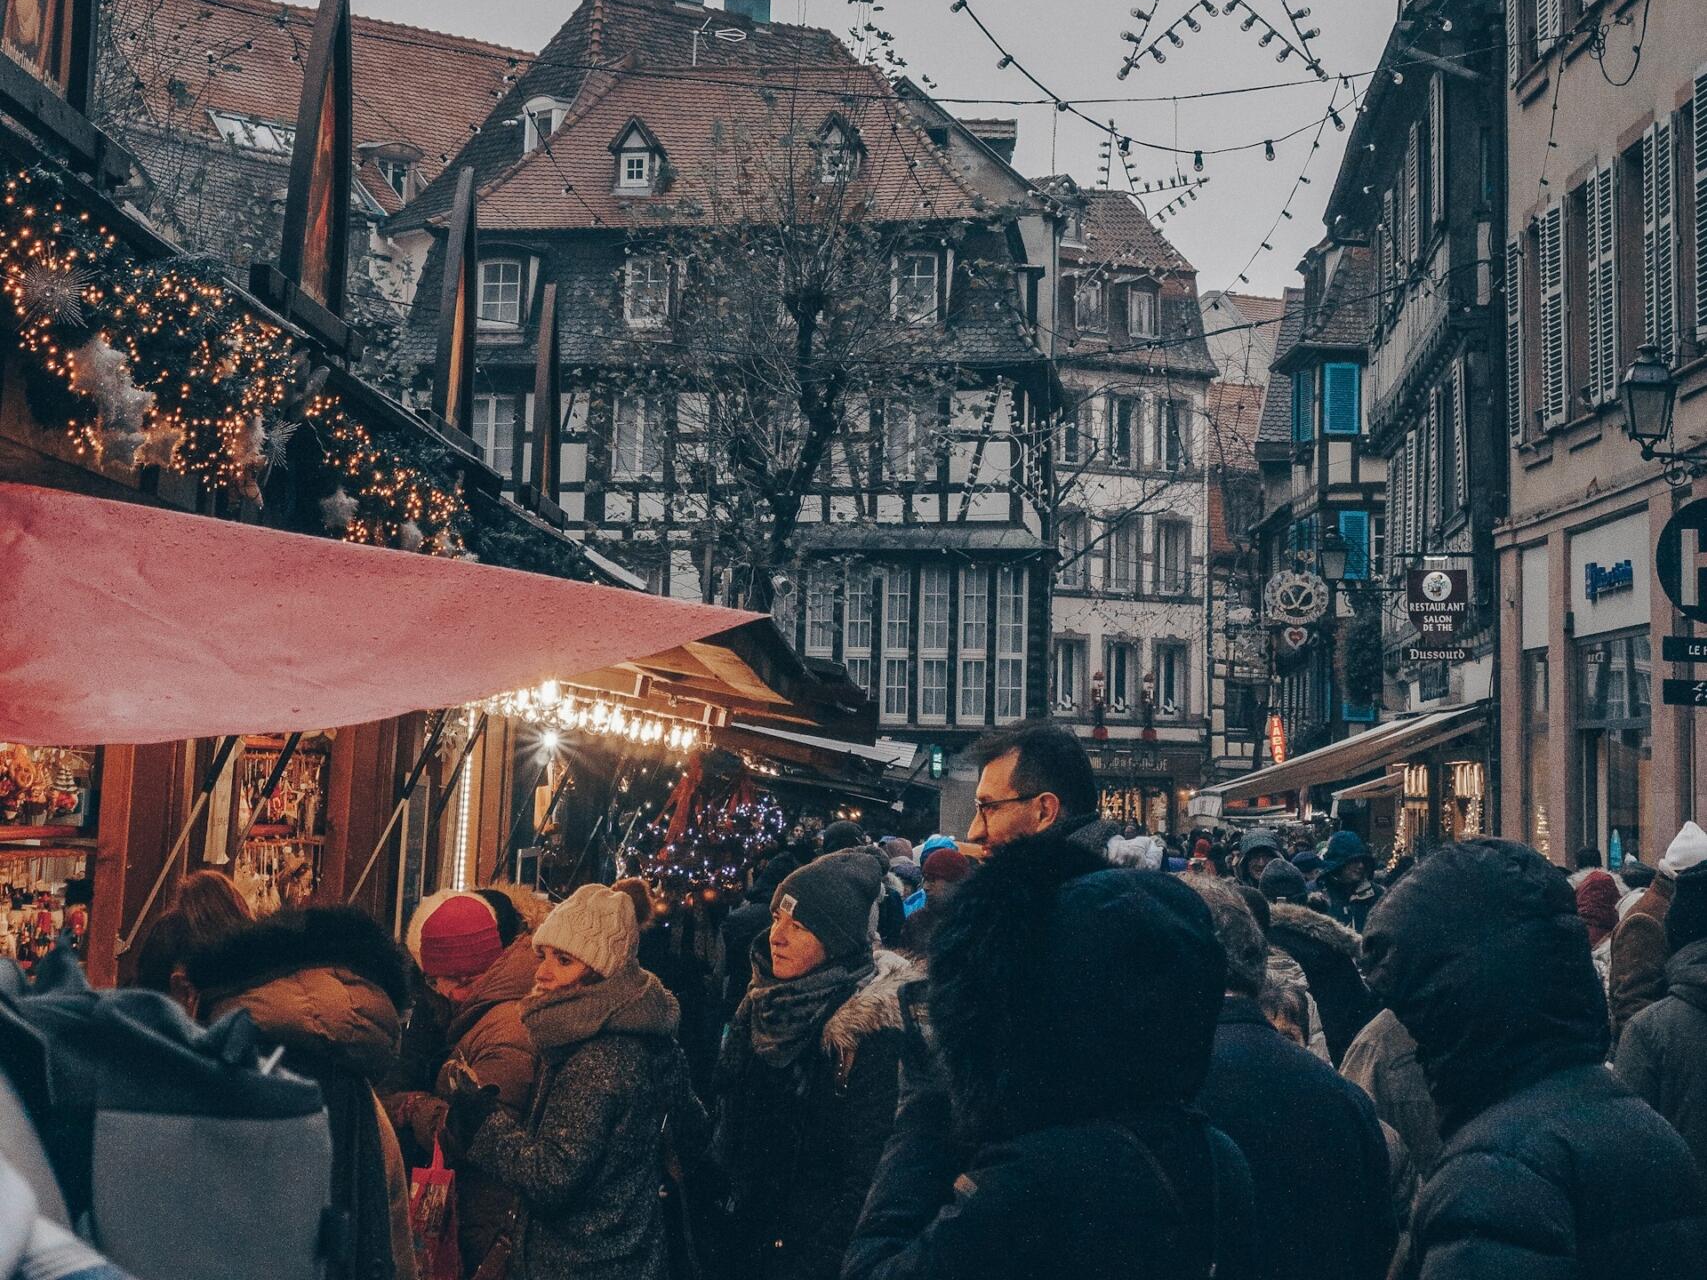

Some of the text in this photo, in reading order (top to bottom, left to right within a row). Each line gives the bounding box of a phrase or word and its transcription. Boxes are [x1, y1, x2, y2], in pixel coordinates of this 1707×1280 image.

[1409, 602, 1465, 612] RESTAURANT
[1423, 615, 1452, 623] SALON
[1423, 623, 1453, 632] DE THE
[1409, 648, 1465, 660] Dussourd
[1688, 644, 1701, 656] LE
[1272, 717, 1283, 763] TABAC
